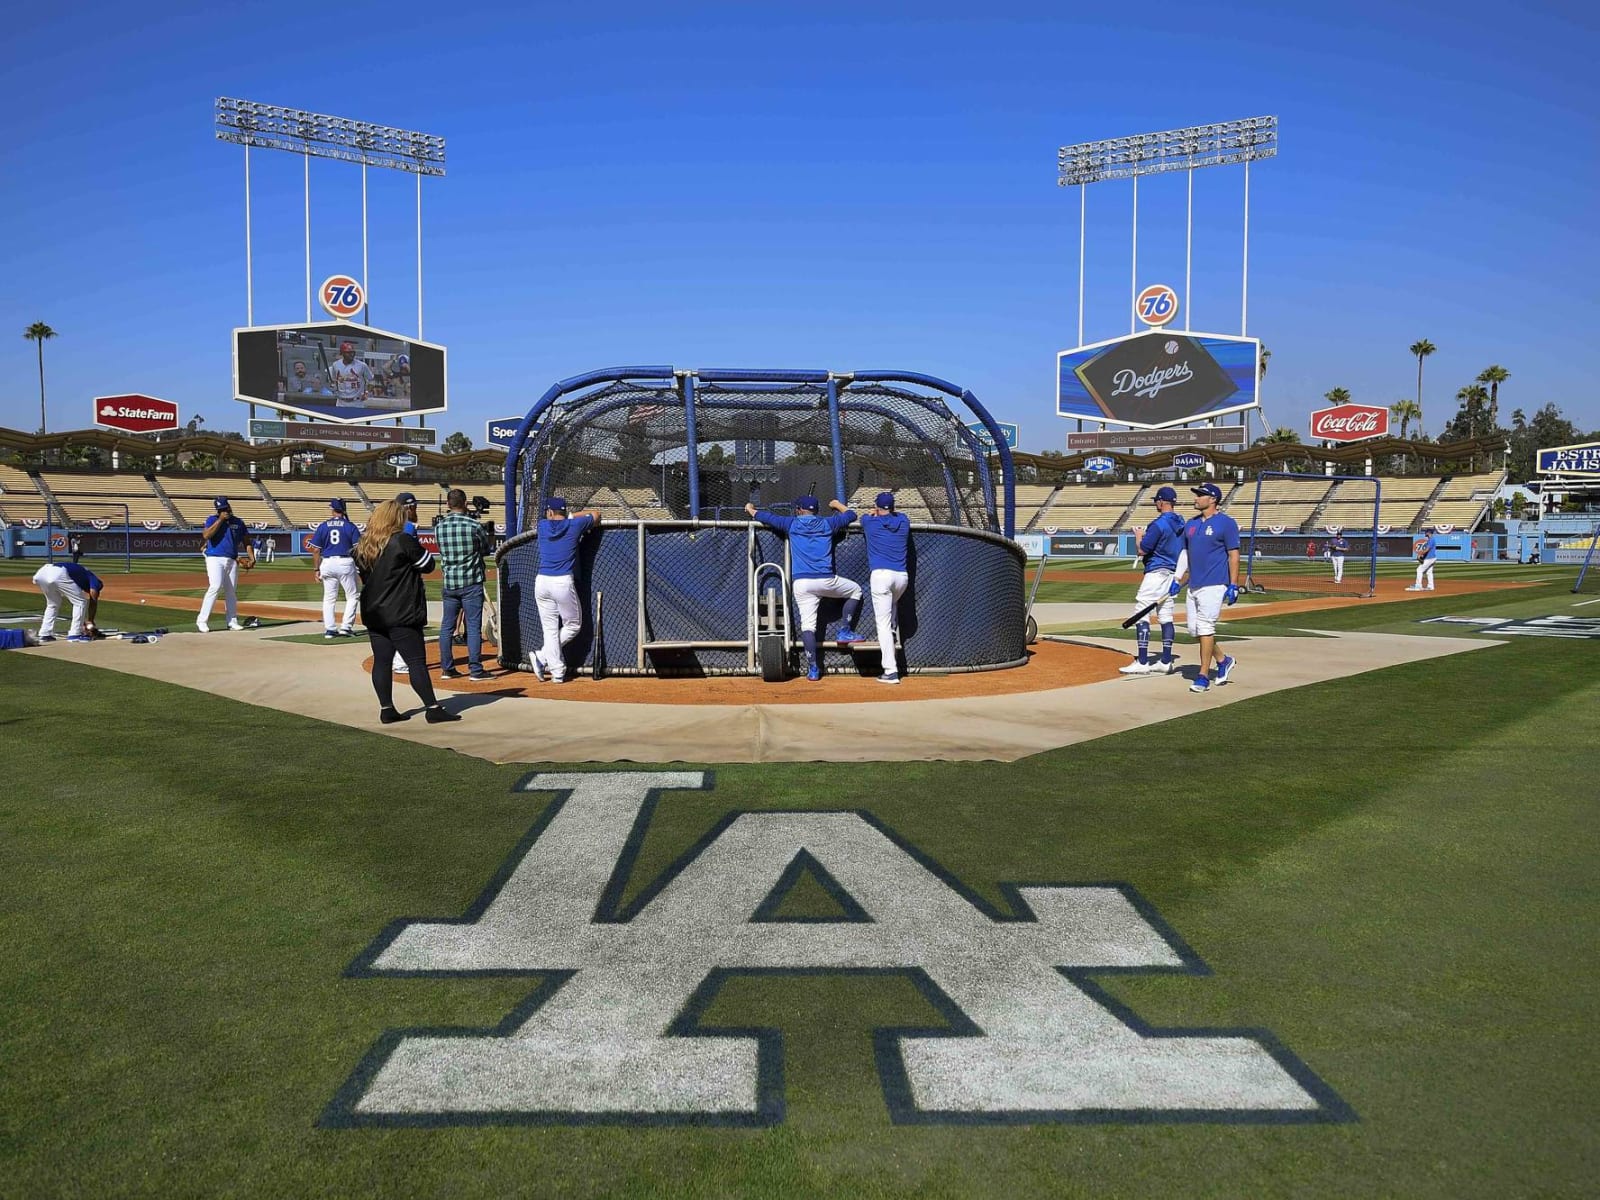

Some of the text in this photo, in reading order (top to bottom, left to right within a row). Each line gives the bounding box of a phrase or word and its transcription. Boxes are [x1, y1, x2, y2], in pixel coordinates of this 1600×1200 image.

[328, 284, 359, 308] 76
[1141, 292, 1172, 317] 76
[1111, 361, 1194, 398] Dodgers
[1317, 412, 1381, 433] Coca-Cola
[1175, 457, 1202, 465] DASANI
[134, 538, 202, 548] OFFICIAL SALTY
[330, 529, 340, 545] 8
[350, 770, 1325, 1114] LA
